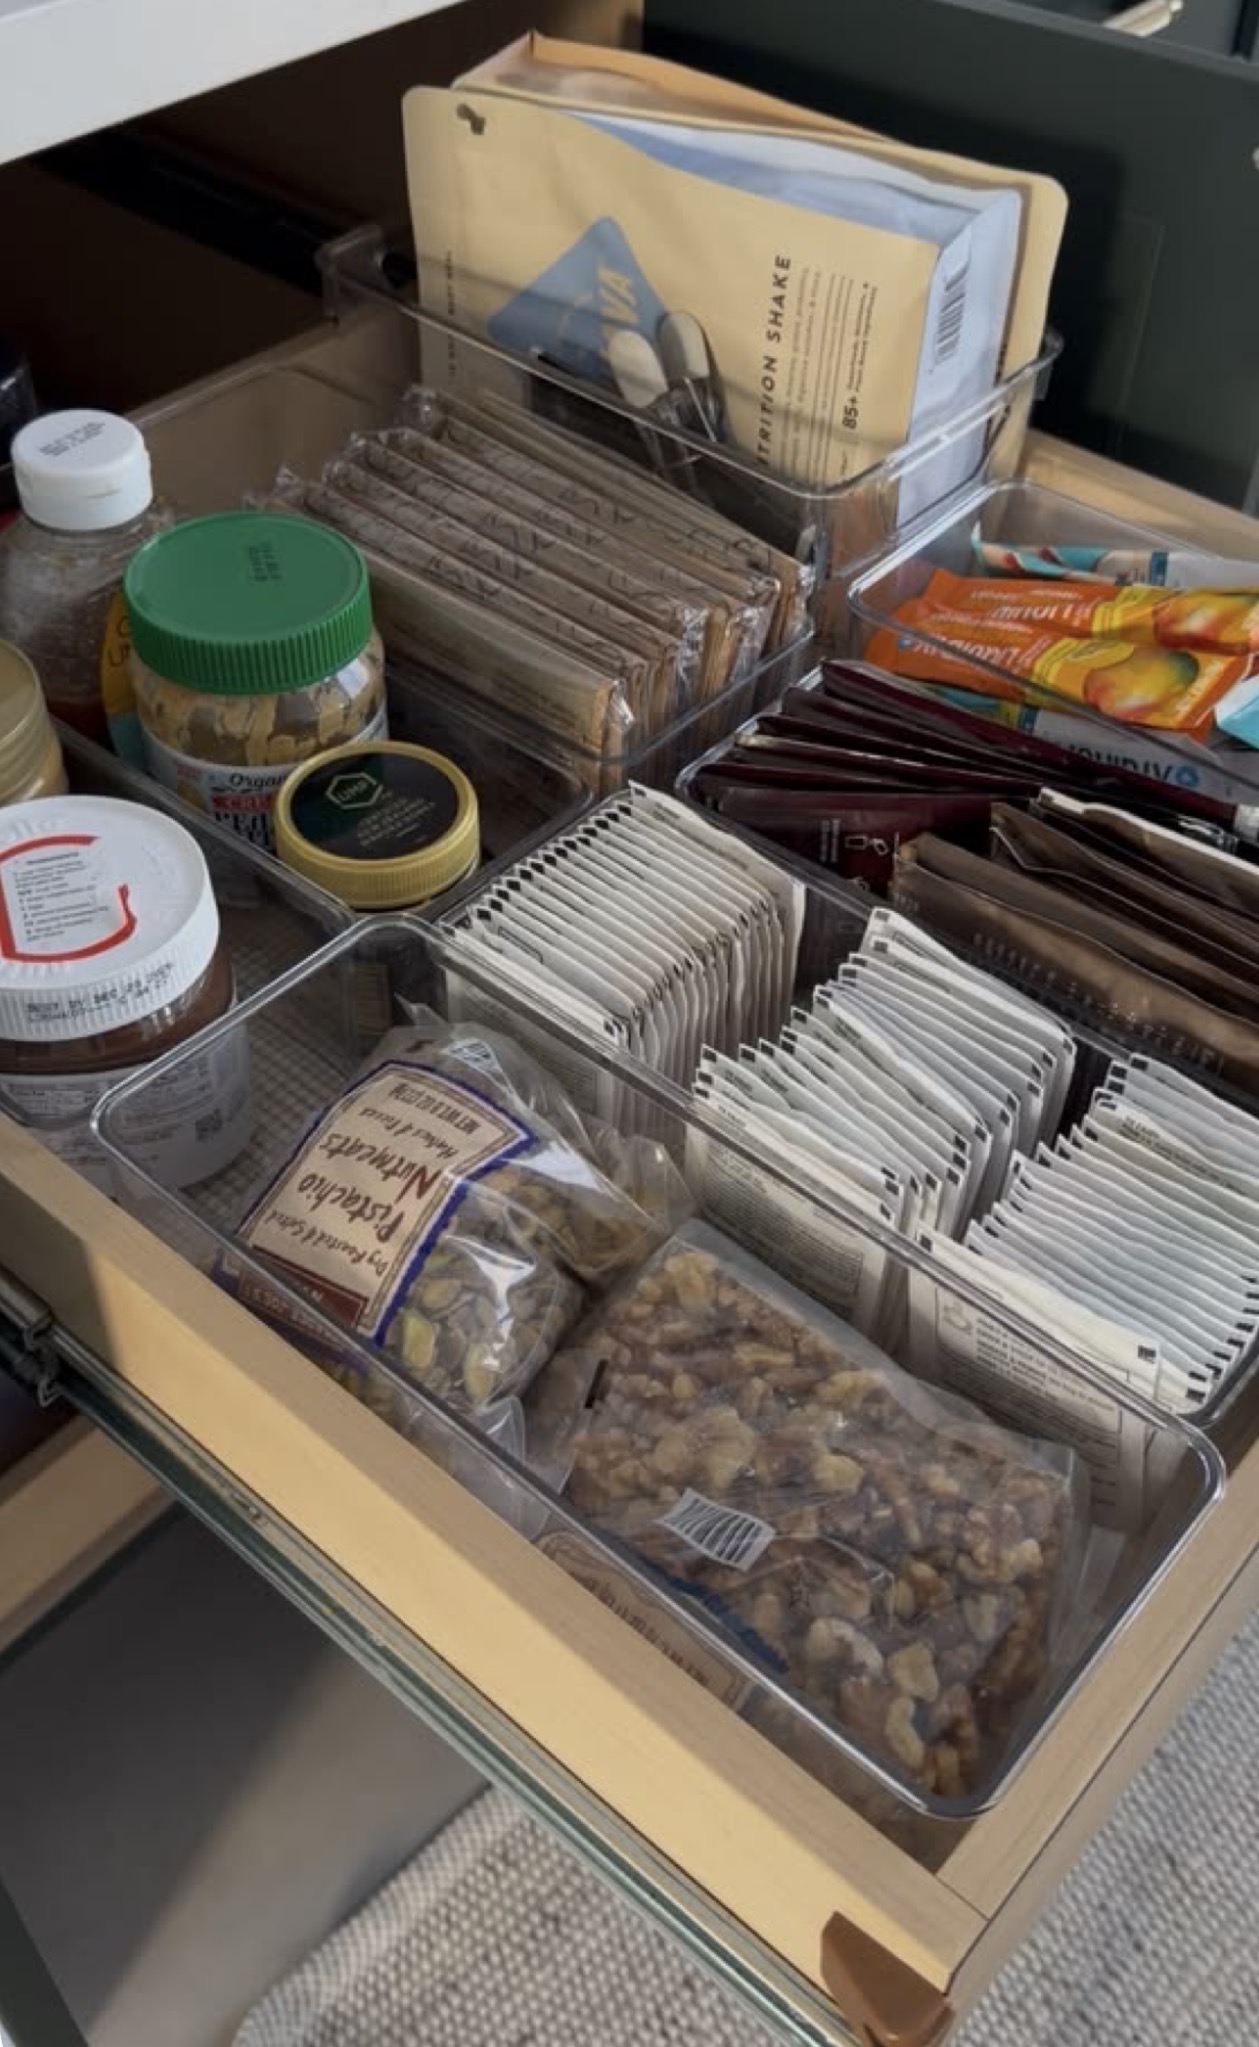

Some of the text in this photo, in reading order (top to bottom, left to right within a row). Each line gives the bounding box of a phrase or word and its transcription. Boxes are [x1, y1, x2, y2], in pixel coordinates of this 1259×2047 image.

[766, 254, 792, 344] SHAKE
[842, 395, 859, 430] 85+
[320, 1132, 443, 1203] Nutmeats
[297, 1173, 404, 1243] Pistachio
[263, 1210, 391, 1277] Dry Roasted & Salted
